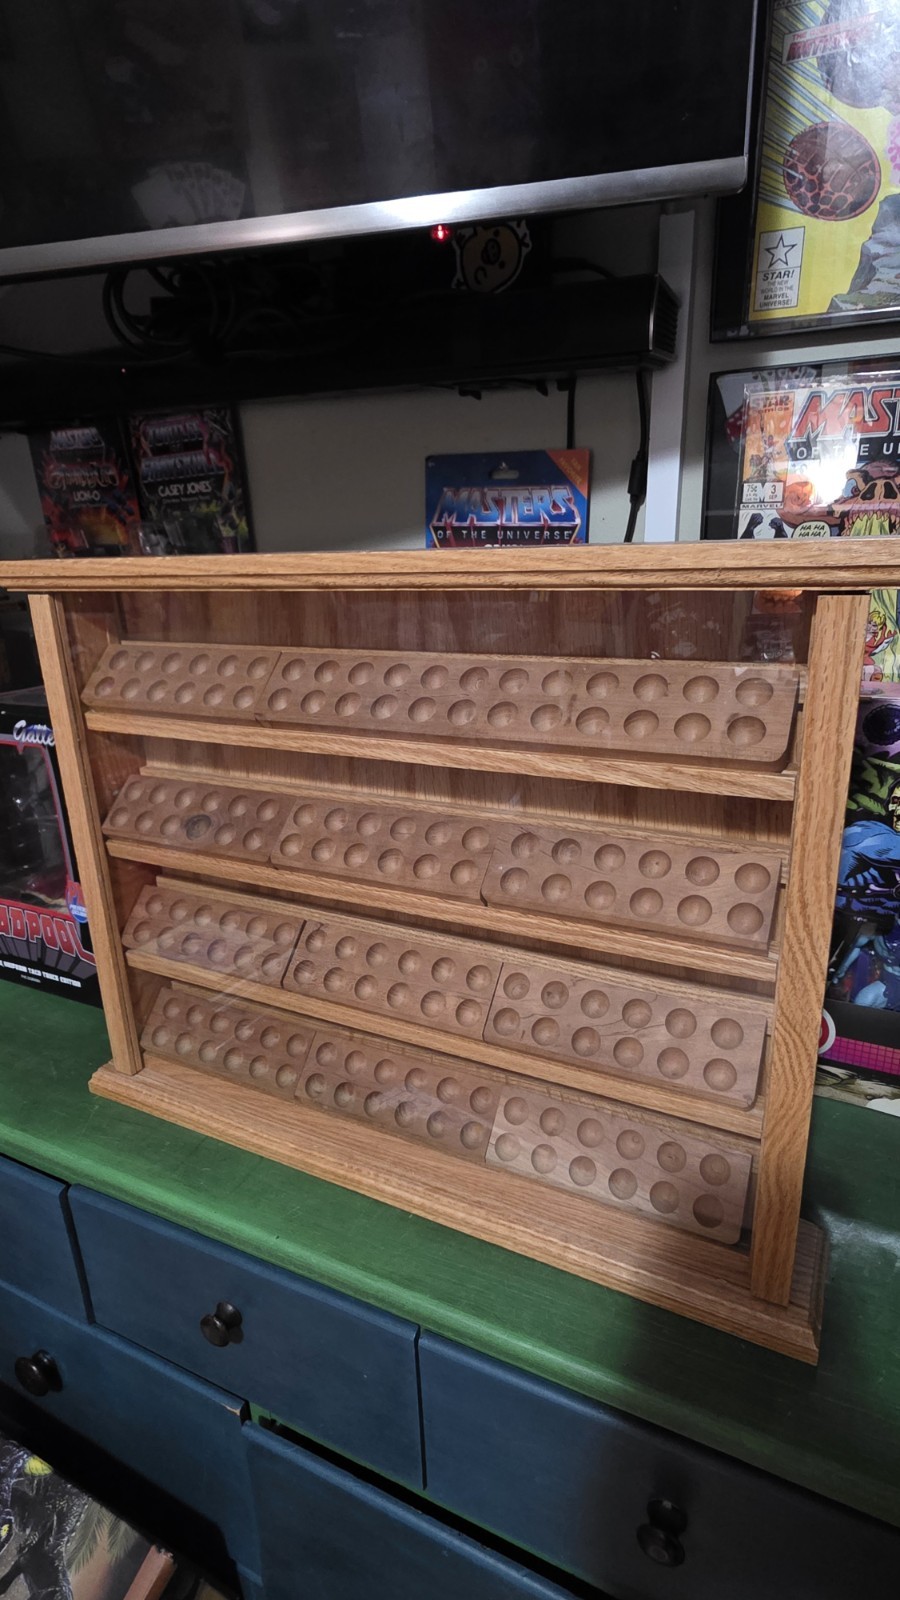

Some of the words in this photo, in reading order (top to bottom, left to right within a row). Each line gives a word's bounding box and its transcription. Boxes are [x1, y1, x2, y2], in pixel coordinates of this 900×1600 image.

[762, 269, 795, 281] STAR!
[760, 286, 778, 294] WORLD
[763, 292, 789, 300] MARVEL
[759, 299, 793, 308] UNIVERSE!
[157, 484, 185, 498] CASEY
[186, 480, 212, 494] JONES
[770, 484, 777, 494] 3
[434, 485, 581, 526] MASTERS
[437, 530, 452, 539] OF
[462, 530, 487, 539] THE
[497, 530, 570, 539] UNIVERSE
